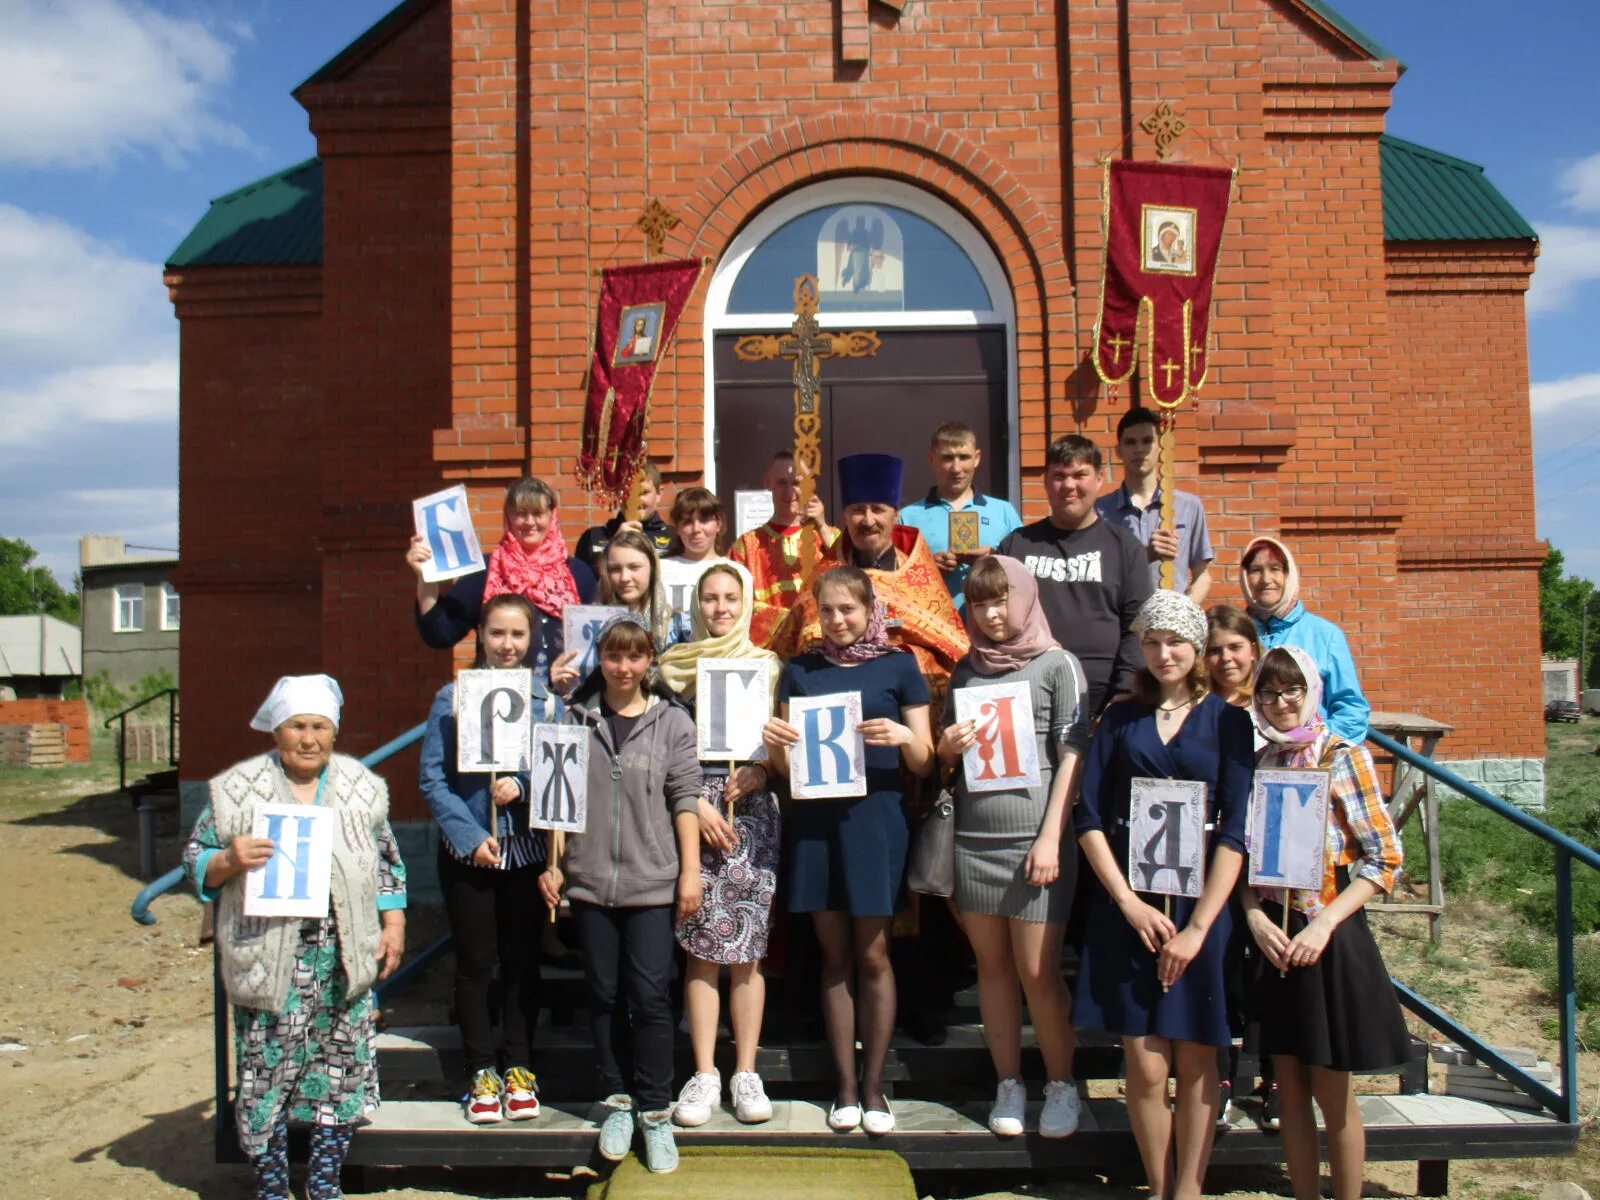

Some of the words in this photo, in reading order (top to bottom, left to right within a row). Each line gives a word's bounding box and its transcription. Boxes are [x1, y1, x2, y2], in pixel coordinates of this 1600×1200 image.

[1024, 551, 1103, 583] RUSSIA
[477, 687, 526, 766] Р
[705, 669, 759, 753] Г
[802, 705, 856, 788] К
[539, 742, 578, 824] Ж
[257, 813, 318, 901] Н
[1138, 800, 1193, 895] Д
[1256, 781, 1318, 878] Г
